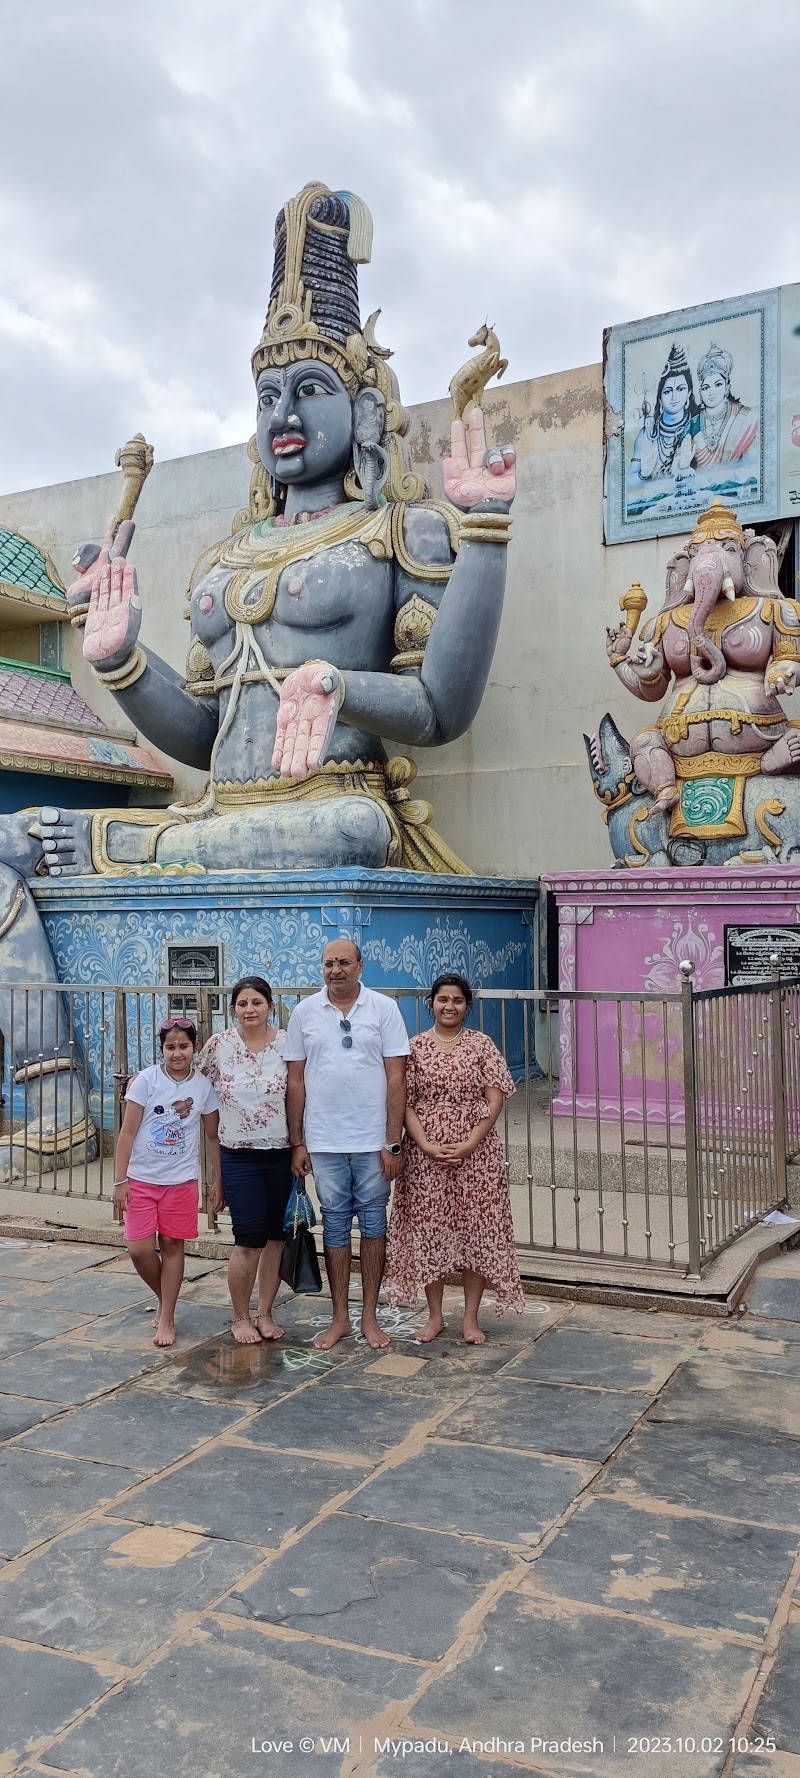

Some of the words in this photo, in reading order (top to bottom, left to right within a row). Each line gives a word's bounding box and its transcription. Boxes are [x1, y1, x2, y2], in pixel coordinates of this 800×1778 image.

[165, 1128, 182, 1139] GIRL
[145, 1140, 167, 1156] Can
[167, 1146, 178, 1156] do
